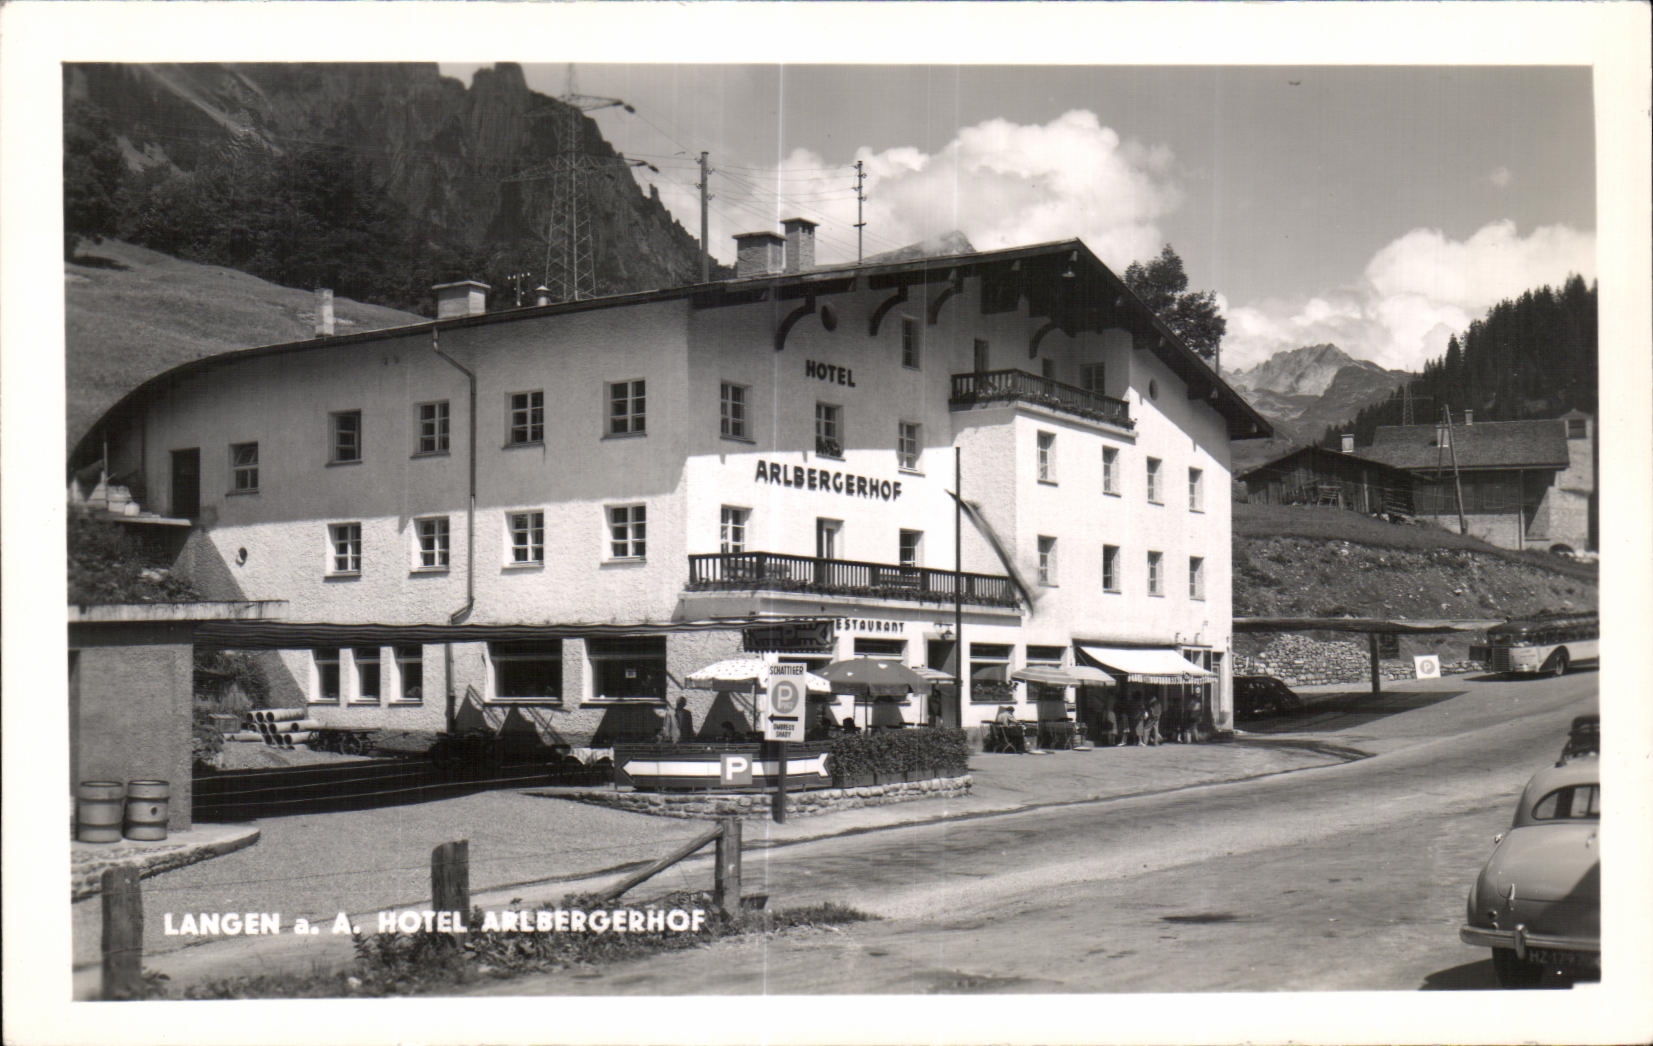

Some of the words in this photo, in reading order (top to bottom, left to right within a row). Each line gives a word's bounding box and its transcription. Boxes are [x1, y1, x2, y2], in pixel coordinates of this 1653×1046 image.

[806, 360, 856, 387] HOTEL
[755, 460, 902, 501] ARLBERGERHOF
[836, 618, 905, 633] ESTAURANT
[769, 665, 804, 676] SCHATTIGER
[777, 685, 793, 710] P
[725, 756, 748, 780] P
